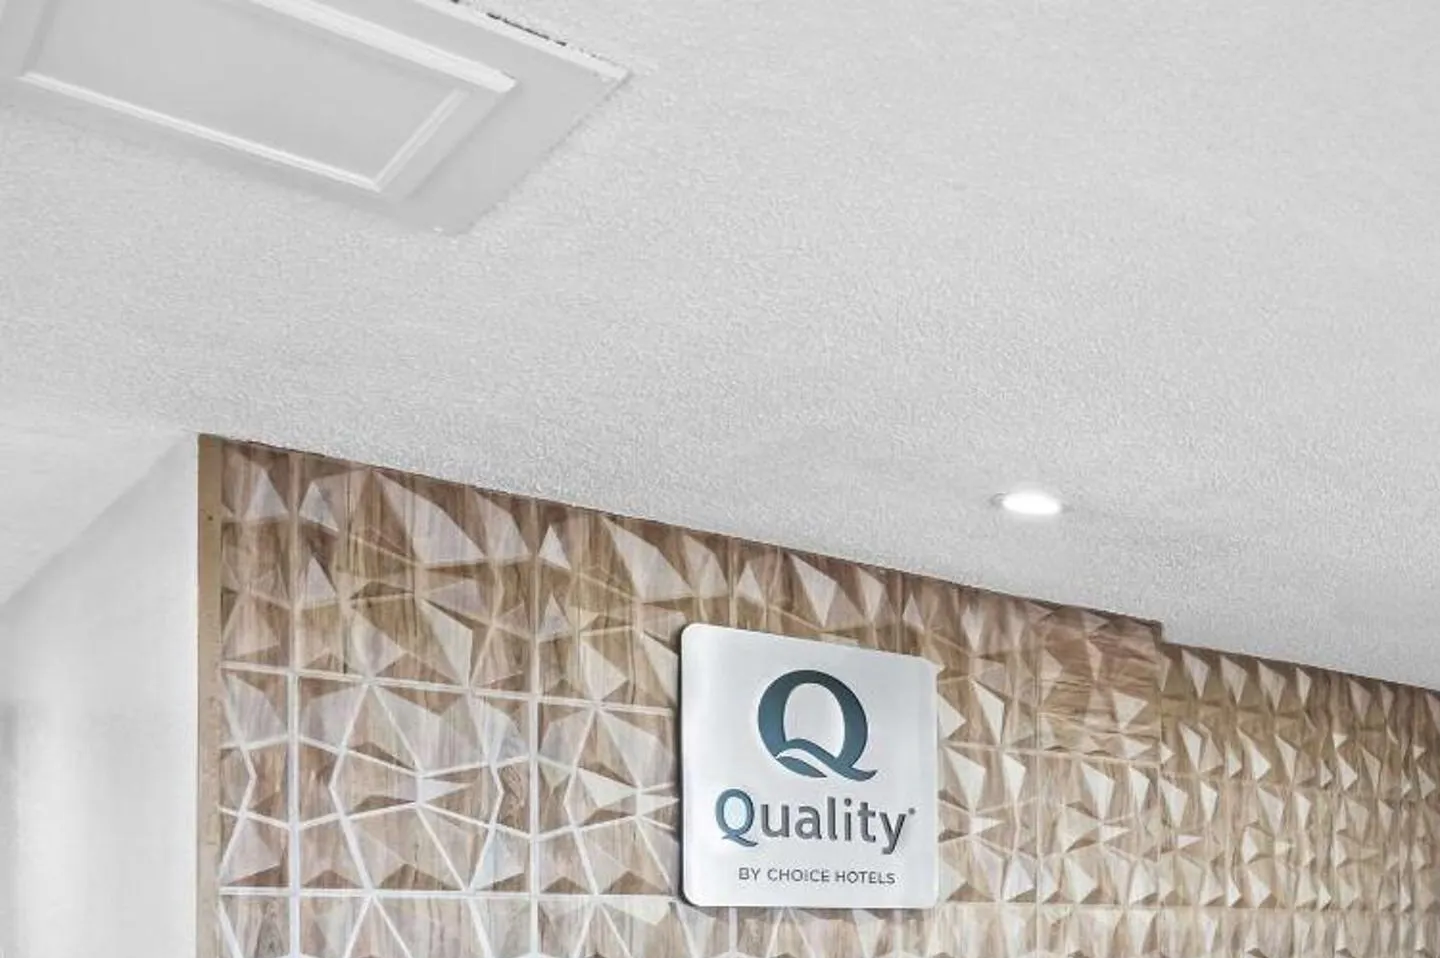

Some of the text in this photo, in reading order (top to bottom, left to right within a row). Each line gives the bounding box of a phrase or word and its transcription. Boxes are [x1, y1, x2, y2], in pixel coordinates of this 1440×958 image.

[758, 669, 878, 782] Q
[715, 788, 909, 855] Quality
[738, 866, 896, 885] BY CHOICE HOTELS
